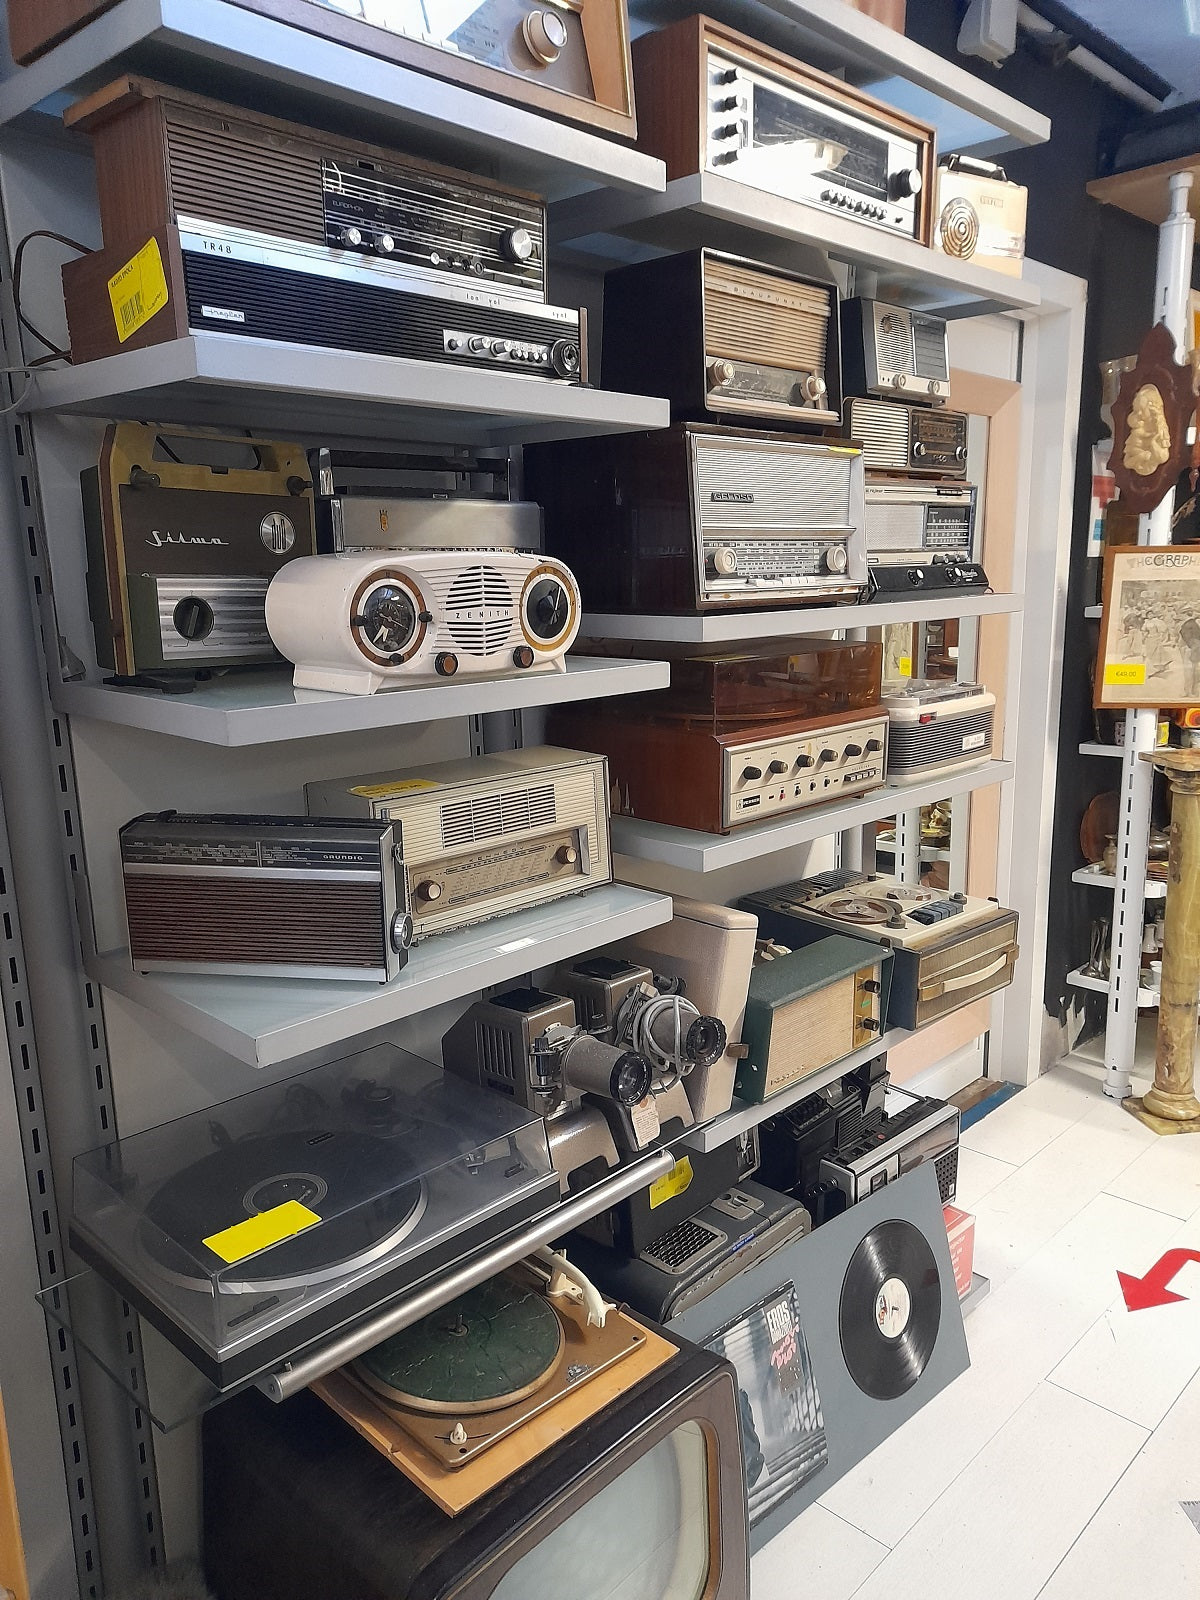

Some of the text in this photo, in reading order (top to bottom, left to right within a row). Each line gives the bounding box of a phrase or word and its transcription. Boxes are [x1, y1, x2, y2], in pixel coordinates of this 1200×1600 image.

[203, 240, 232, 254] TR48
[733, 286, 803, 307] BLAUPUNKT
[145, 530, 229, 547] Silma
[455, 609, 509, 620] ZENITH
[766, 1300, 791, 1331] EROS
